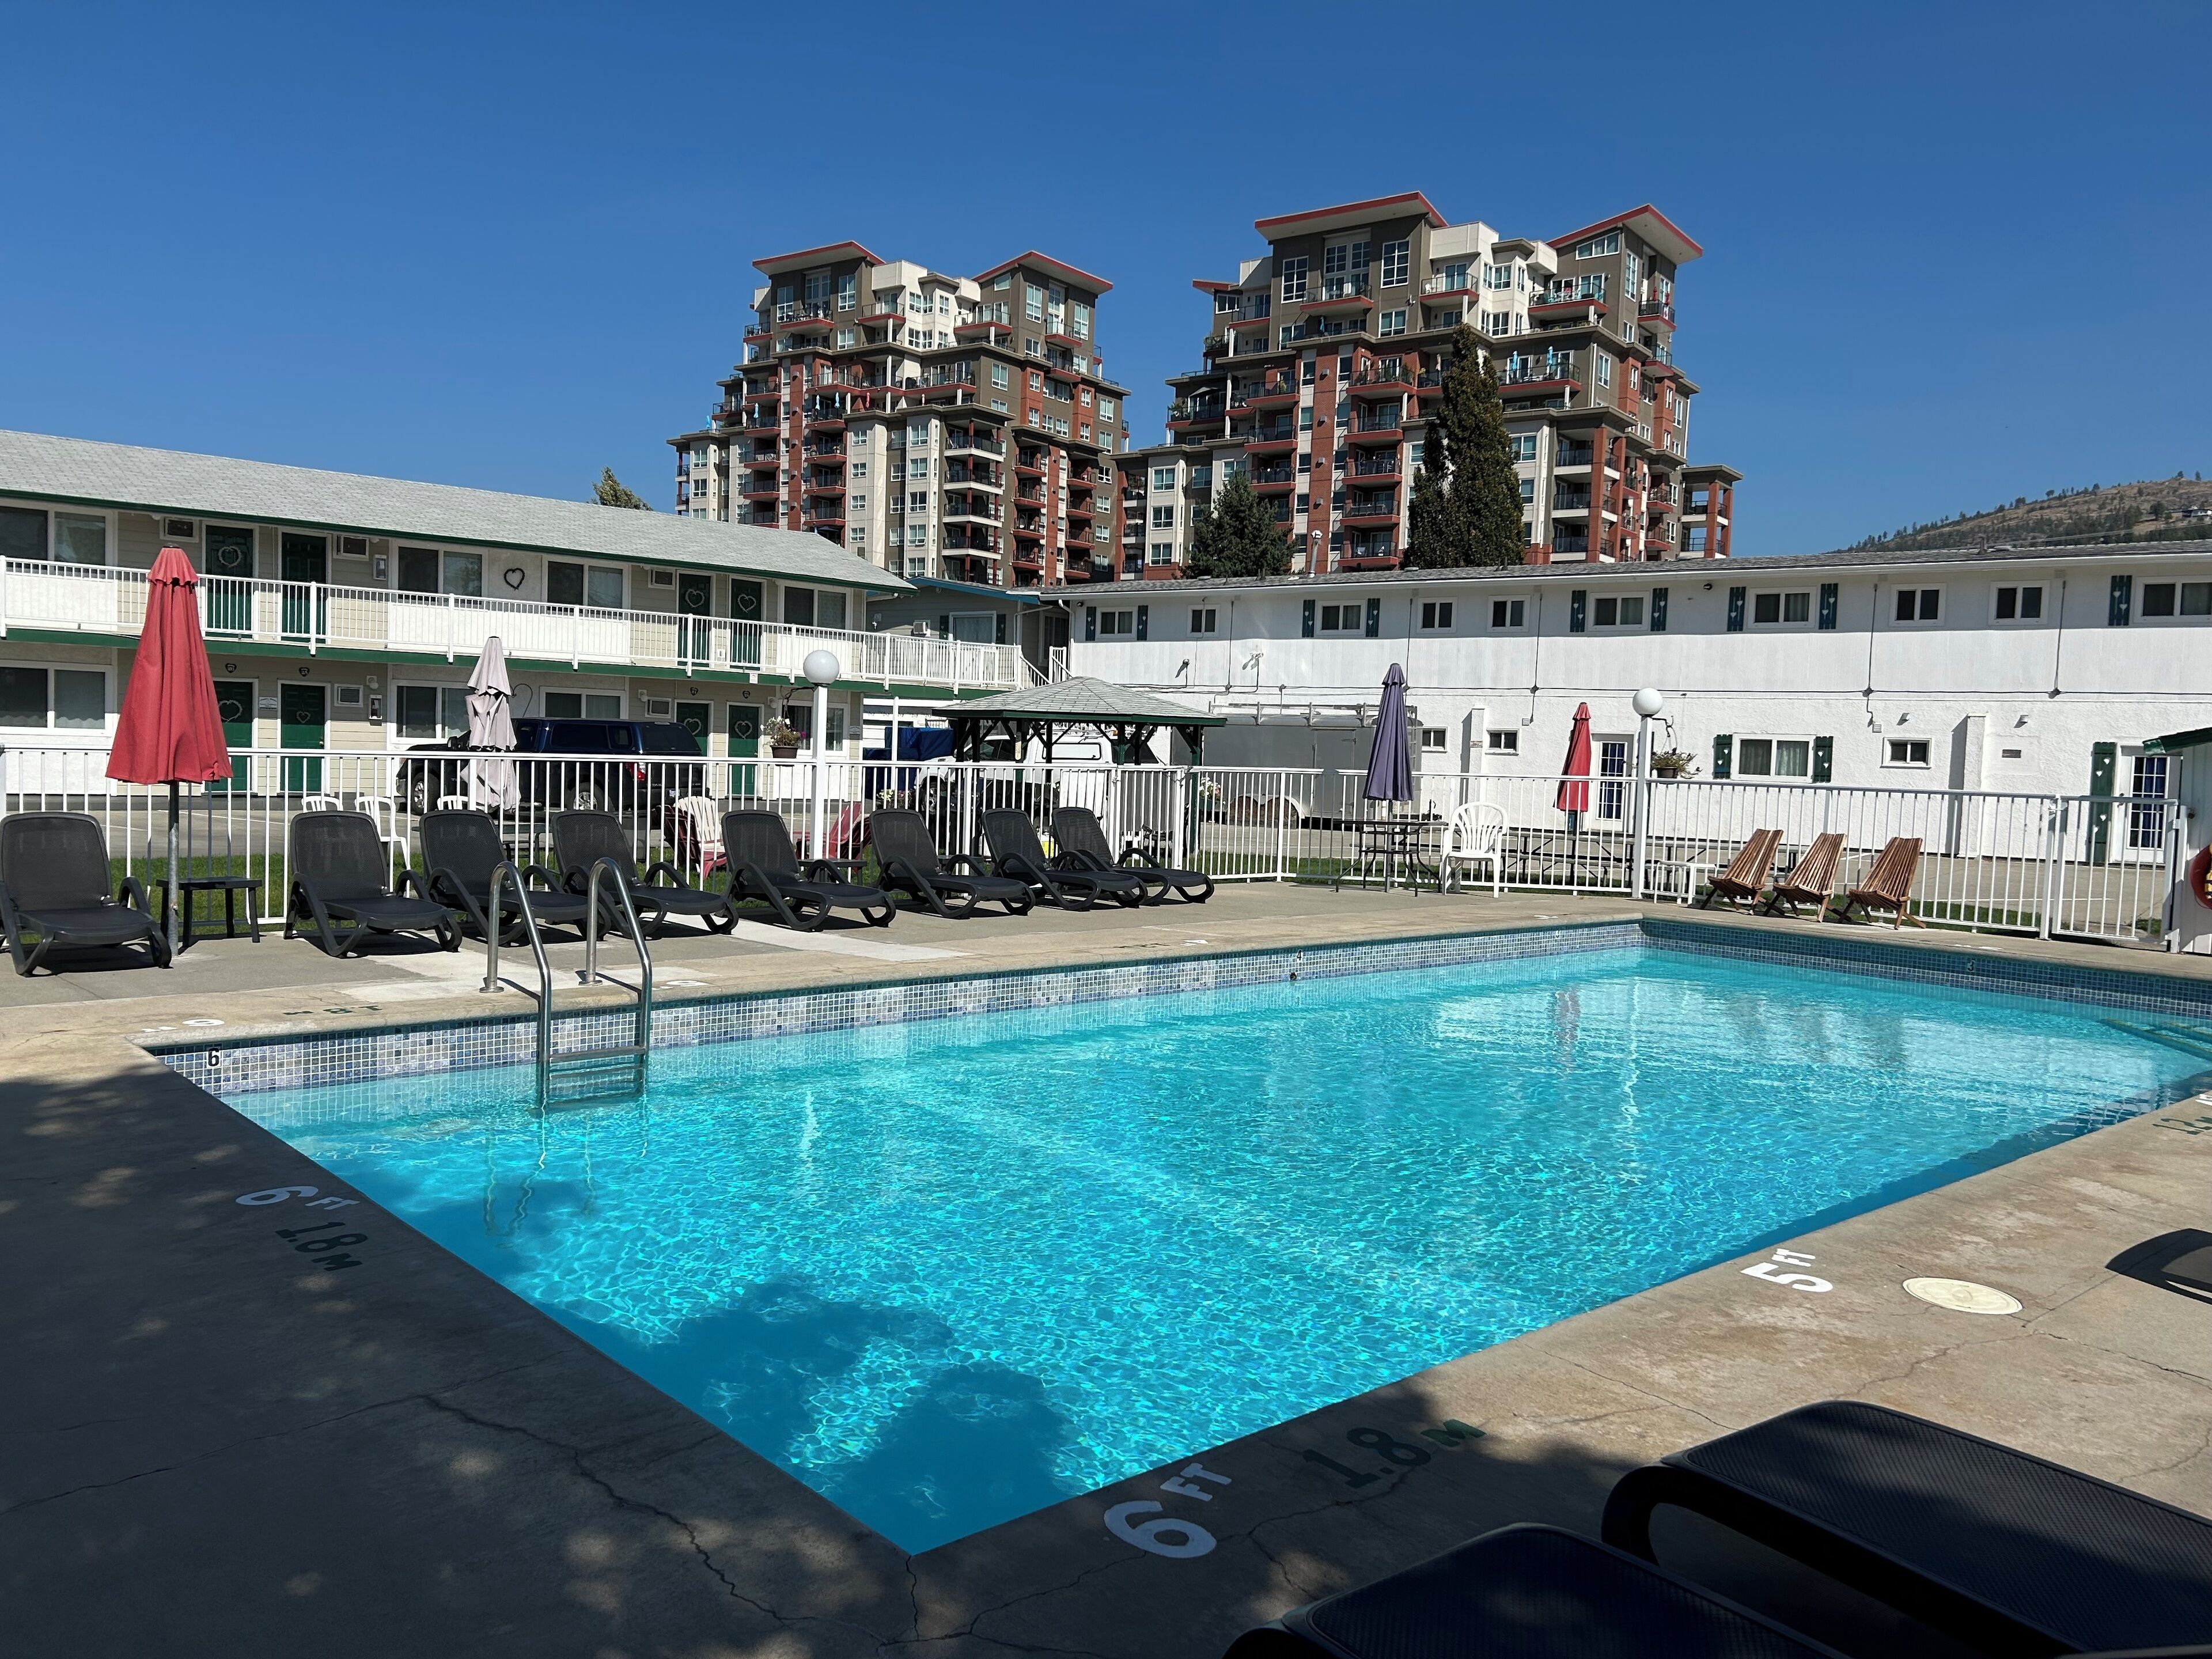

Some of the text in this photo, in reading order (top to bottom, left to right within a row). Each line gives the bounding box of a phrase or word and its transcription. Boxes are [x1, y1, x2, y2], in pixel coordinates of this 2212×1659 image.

[1296, 950, 1302, 961] 4
[1967, 960, 1975, 972] 3
[208, 1047, 219, 1067] 6
[235, 1185, 361, 1210] 6 FT
[275, 1222, 368, 1271] 1.8 M
[1740, 1248, 1834, 1293] 5 FT
[1302, 1419, 1487, 1489] 1.8 M
[1103, 1462, 1232, 1559] 6 FT
